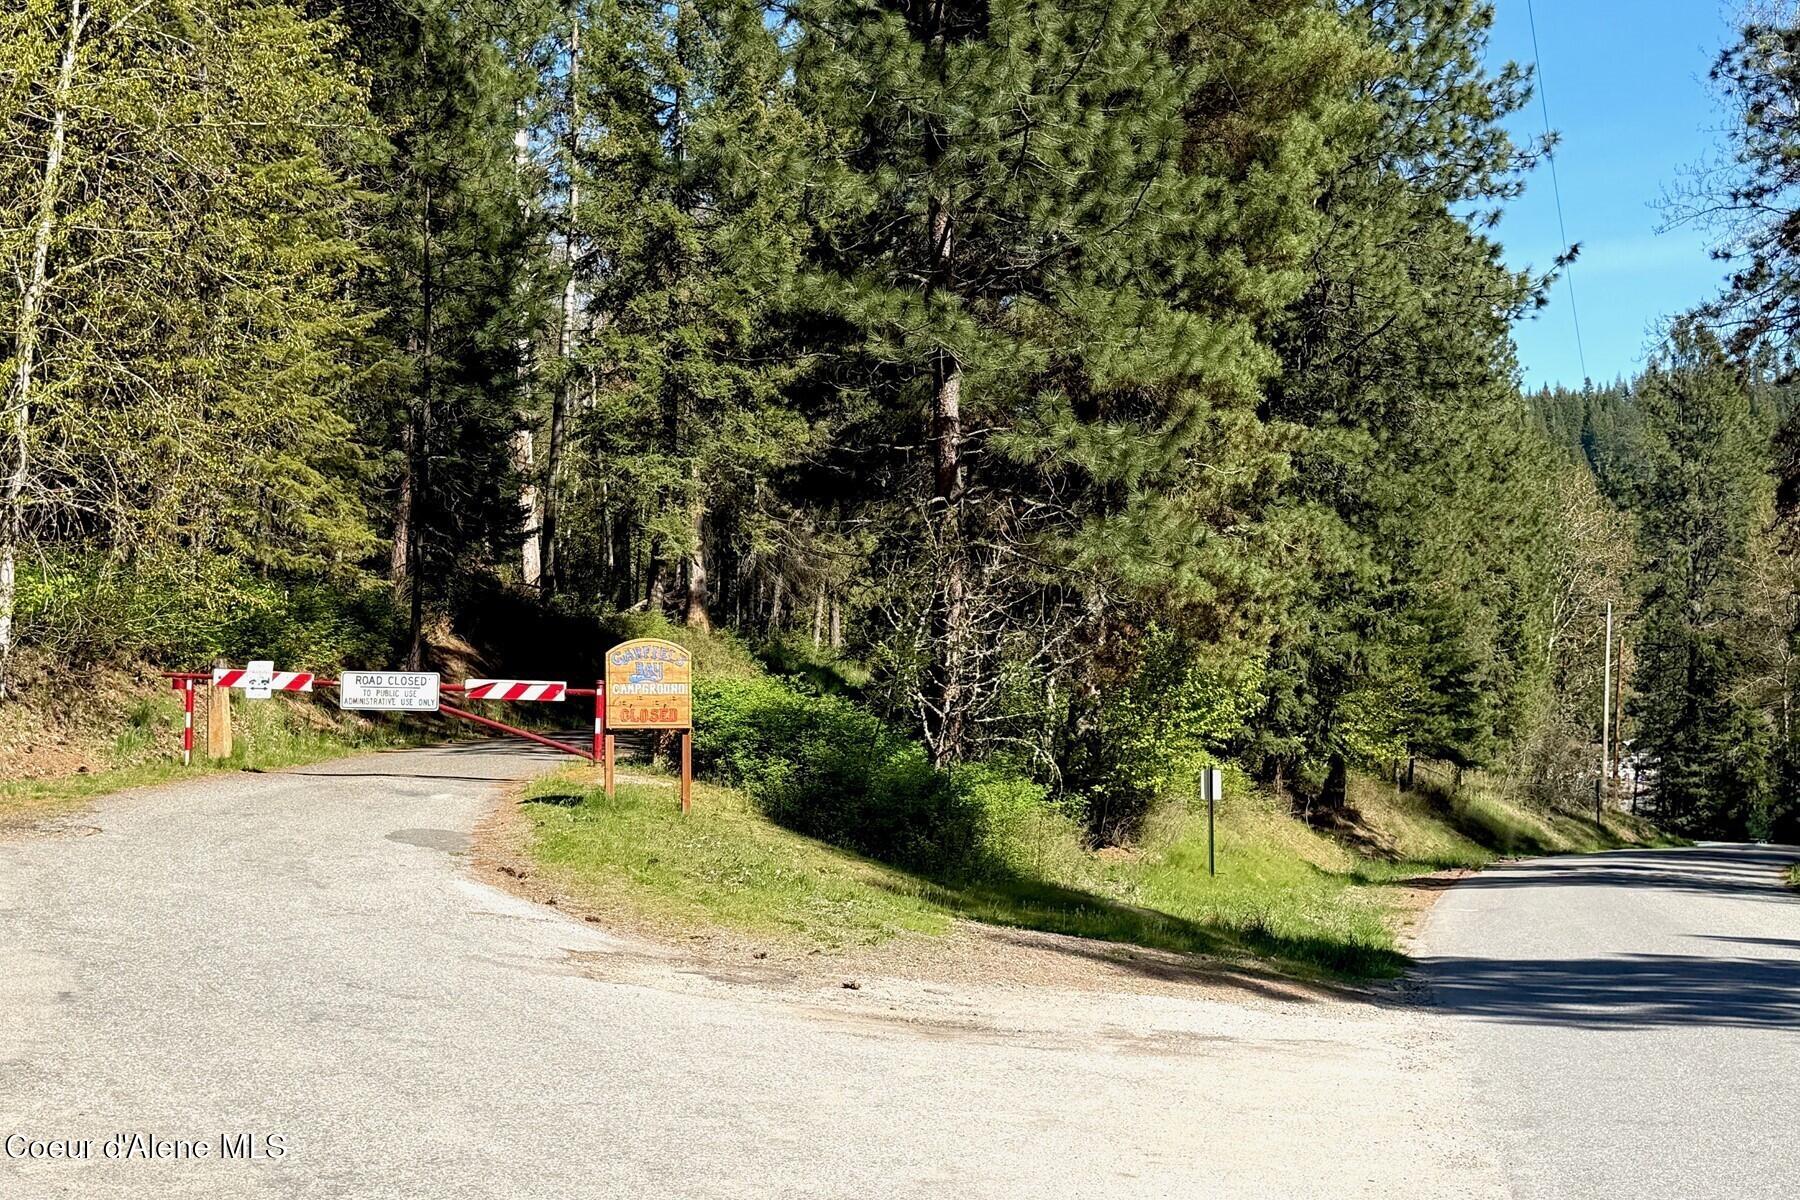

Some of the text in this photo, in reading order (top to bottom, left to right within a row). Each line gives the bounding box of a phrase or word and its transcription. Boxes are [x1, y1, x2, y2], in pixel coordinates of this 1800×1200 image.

[355, 675, 427, 686] ROAD CLOSED
[363, 689, 371, 697] TO
[375, 689, 400, 697] PUBLIC
[612, 683, 687, 695] CAMPGROUND
[344, 697, 435, 706] ADMINISTRATIVE USE ONLY
[621, 708, 678, 722] CLOSED
